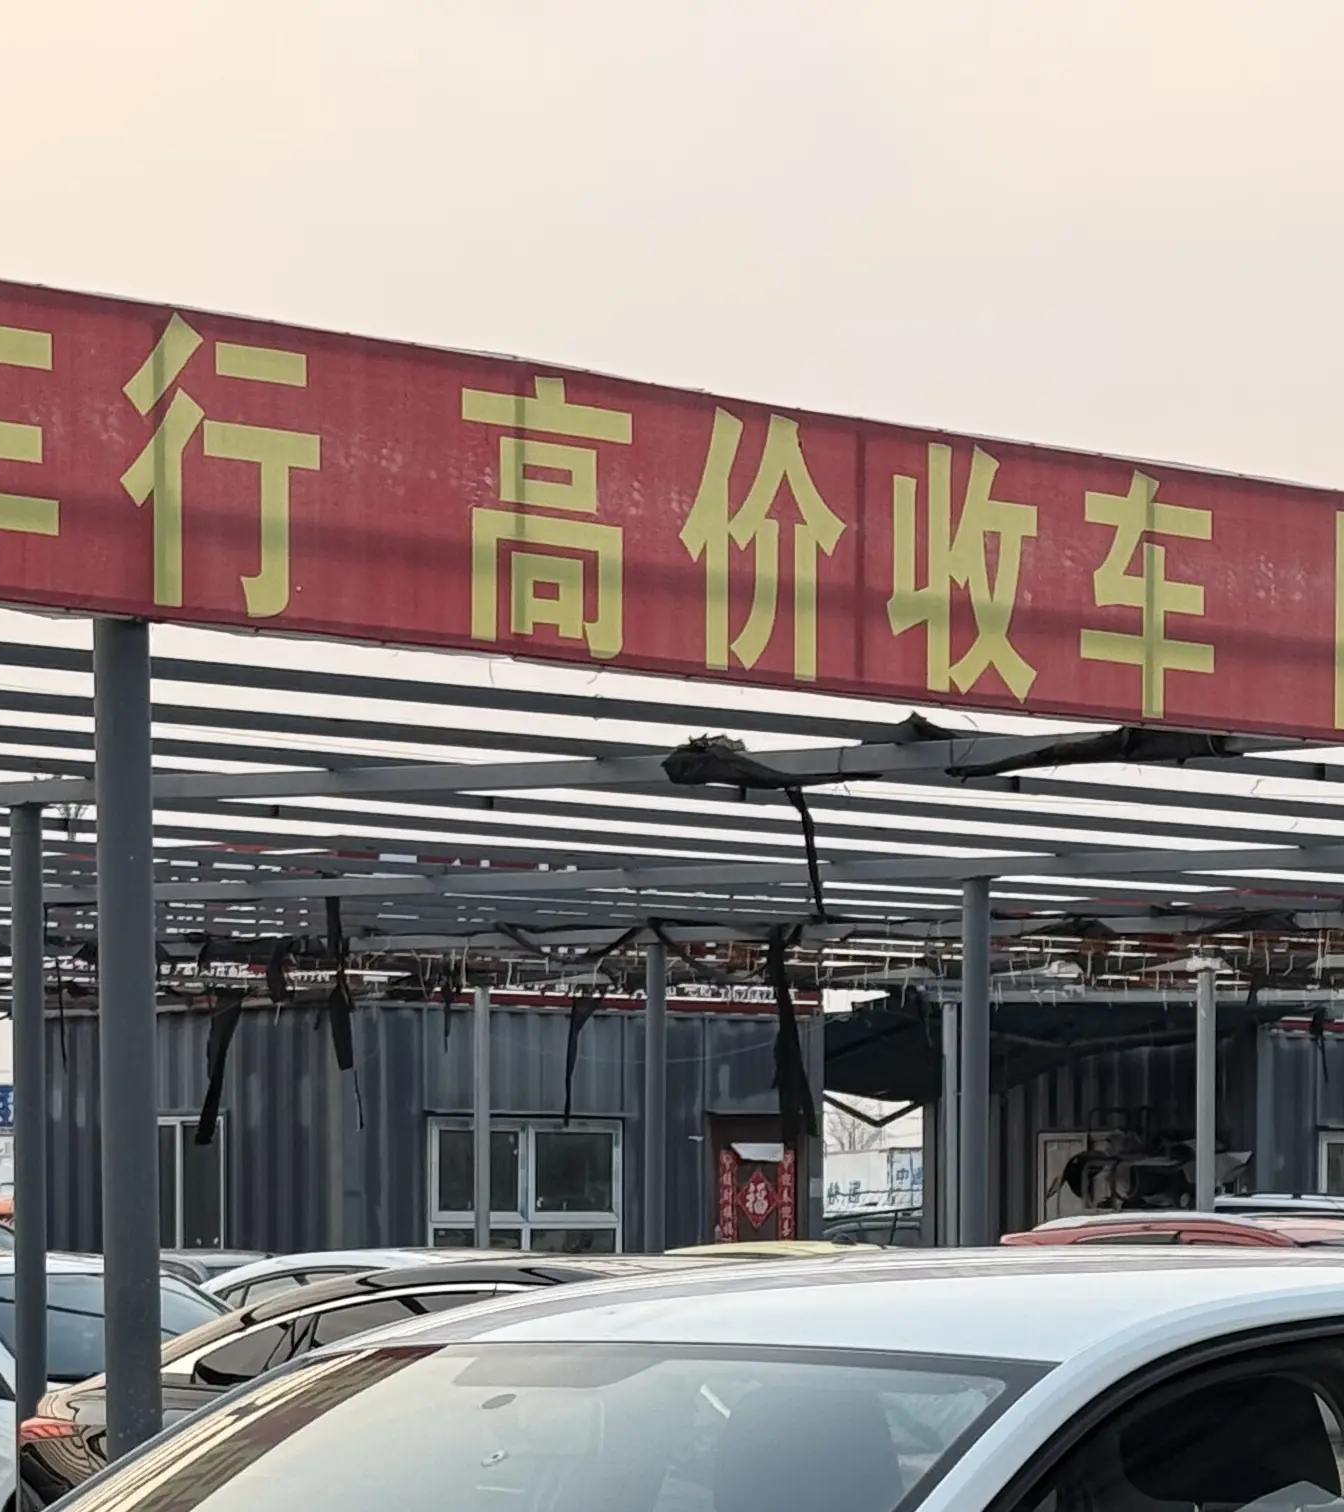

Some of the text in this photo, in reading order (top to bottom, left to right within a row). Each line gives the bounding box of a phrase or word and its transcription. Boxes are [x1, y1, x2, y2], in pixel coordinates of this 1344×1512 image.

[462, 376, 1214, 720] 高价收车
[745, 1182, 769, 1215] 福
